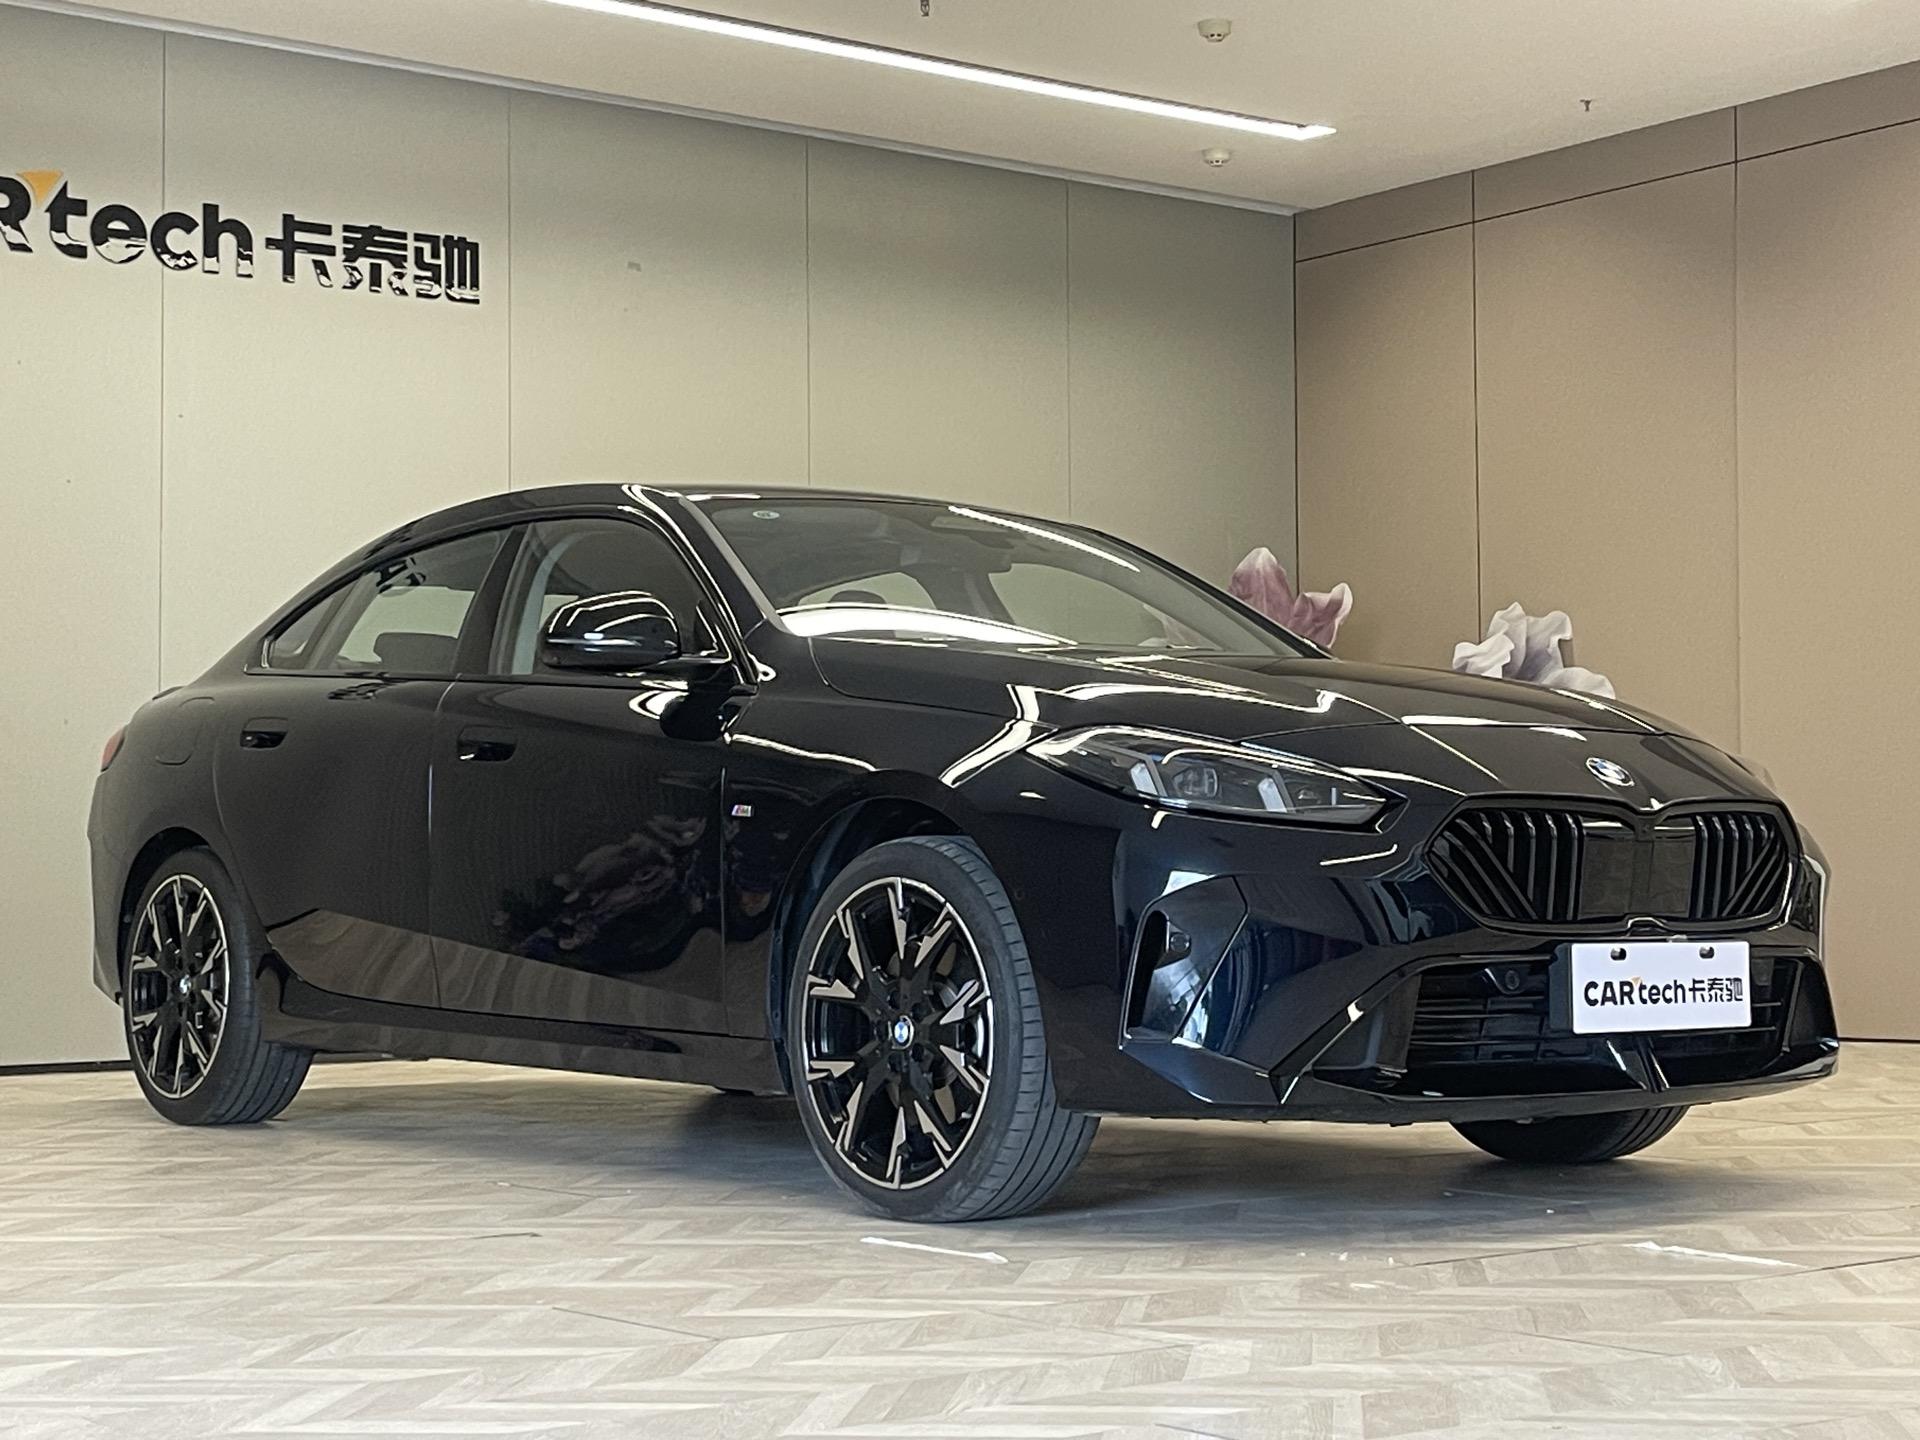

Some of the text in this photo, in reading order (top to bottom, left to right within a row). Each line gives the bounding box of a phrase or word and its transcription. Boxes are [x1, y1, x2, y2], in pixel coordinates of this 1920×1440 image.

[265, 213, 480, 305] 卡泰驰
[1584, 977, 1744, 1007] CARtech 卡泰驰
